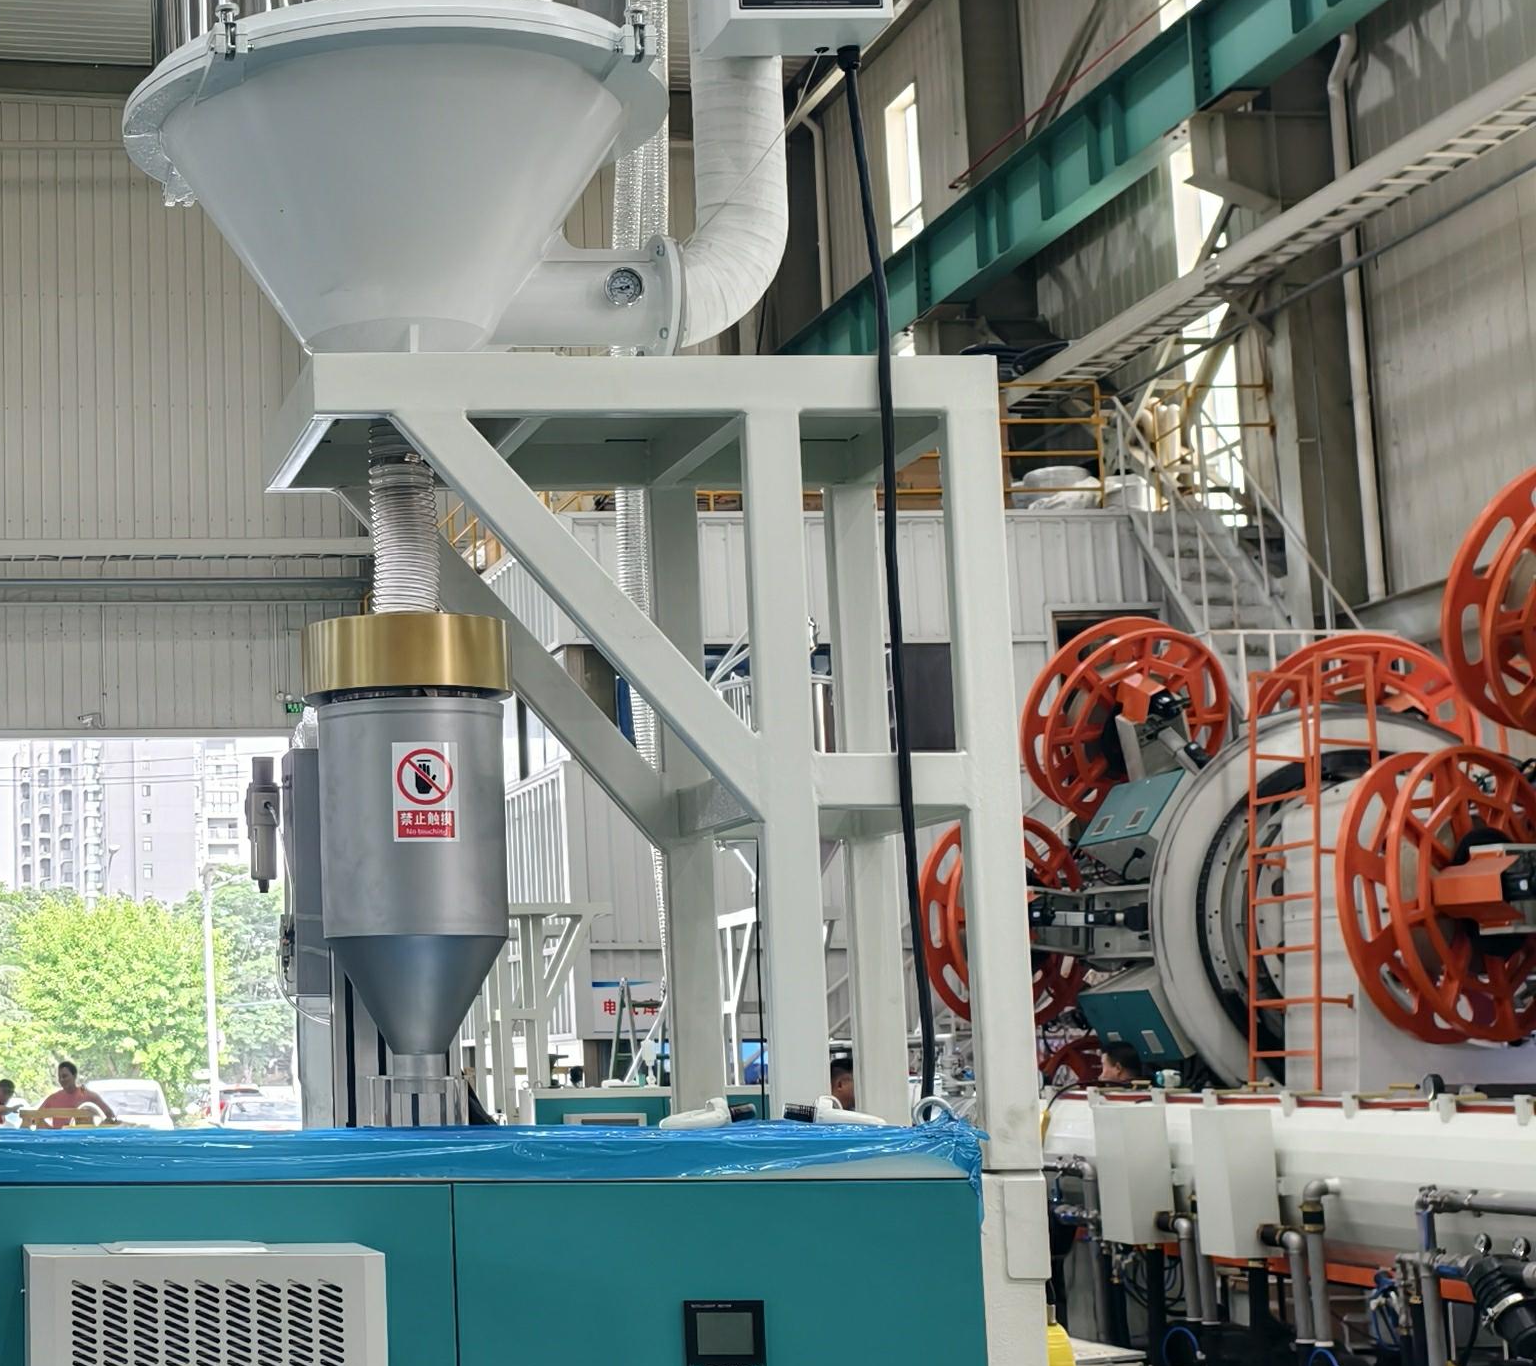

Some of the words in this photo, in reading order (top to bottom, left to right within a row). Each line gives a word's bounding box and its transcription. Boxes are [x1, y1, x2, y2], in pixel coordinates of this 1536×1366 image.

[400, 812, 453, 826] 禁止触摸
[418, 827, 448, 836] touching
